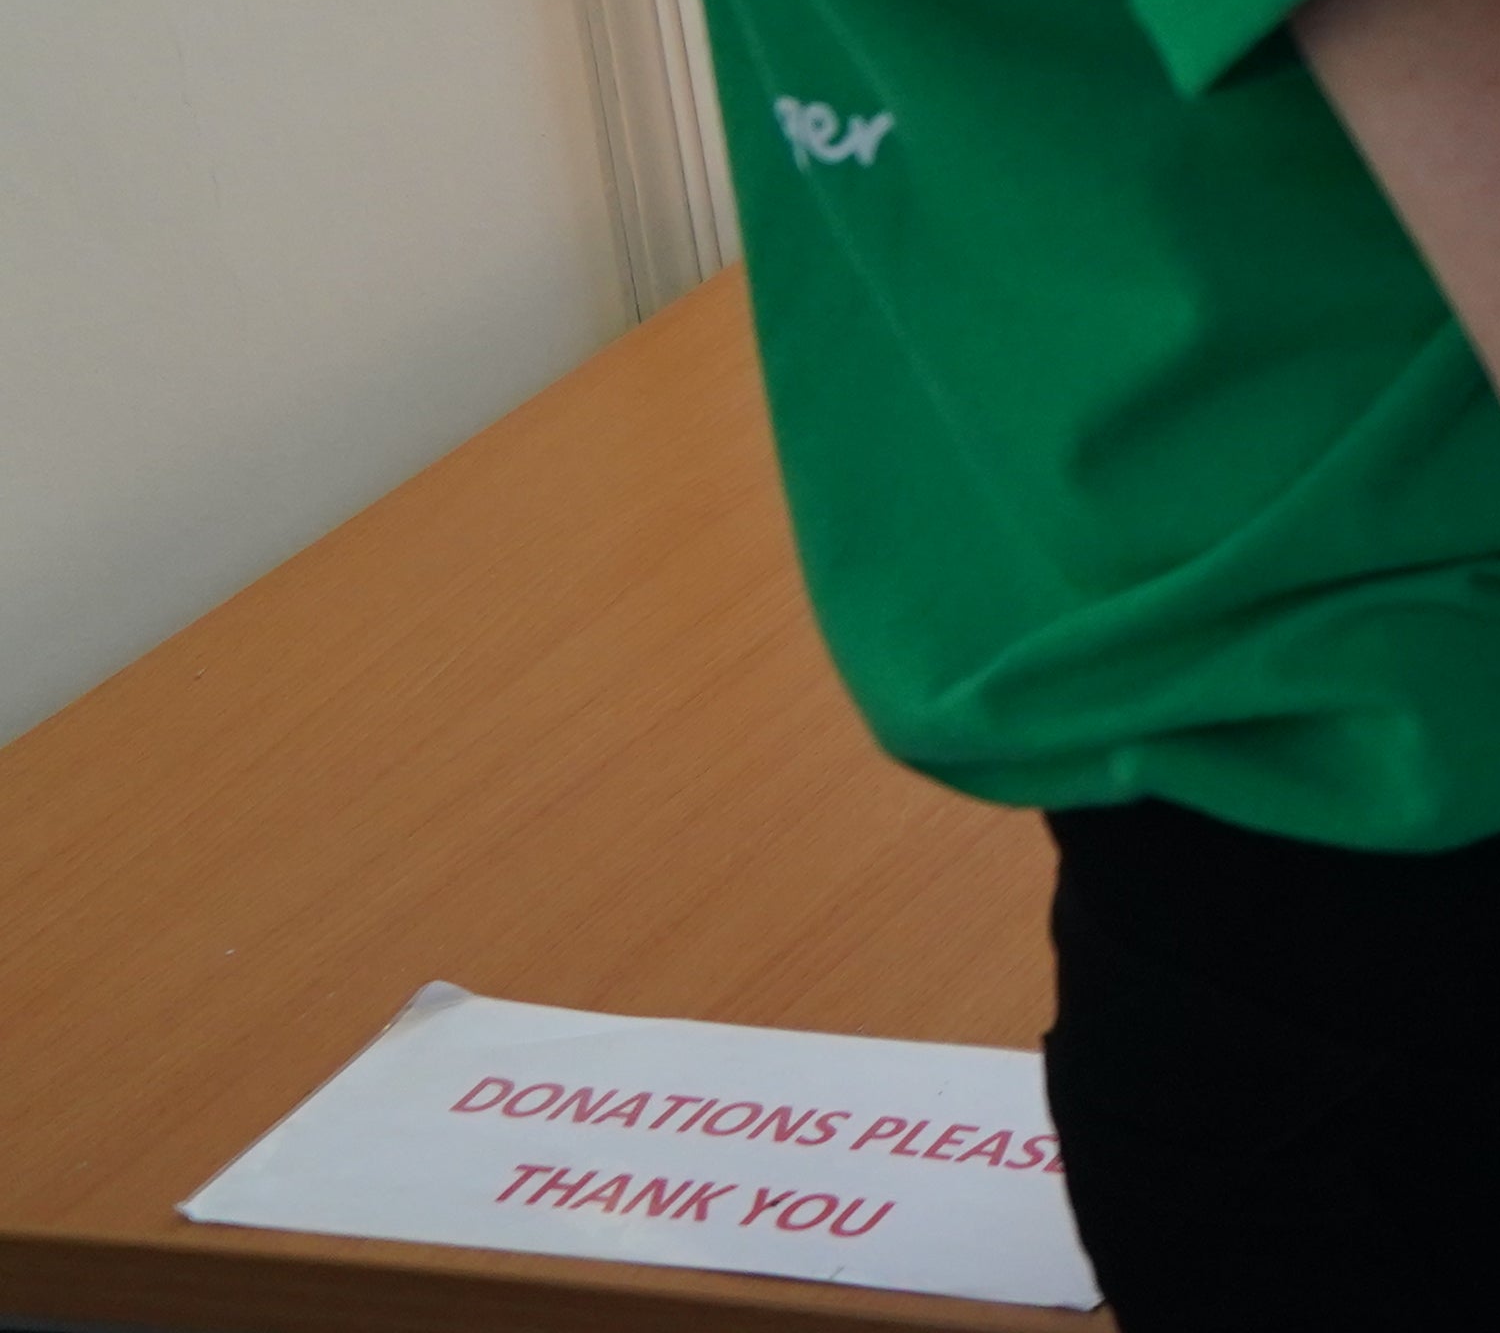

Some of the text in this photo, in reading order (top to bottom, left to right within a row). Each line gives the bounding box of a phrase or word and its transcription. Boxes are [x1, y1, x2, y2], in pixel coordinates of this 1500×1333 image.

[451, 1076, 853, 1148] DONATIONS
[494, 1163, 899, 1238] THANK YOU
